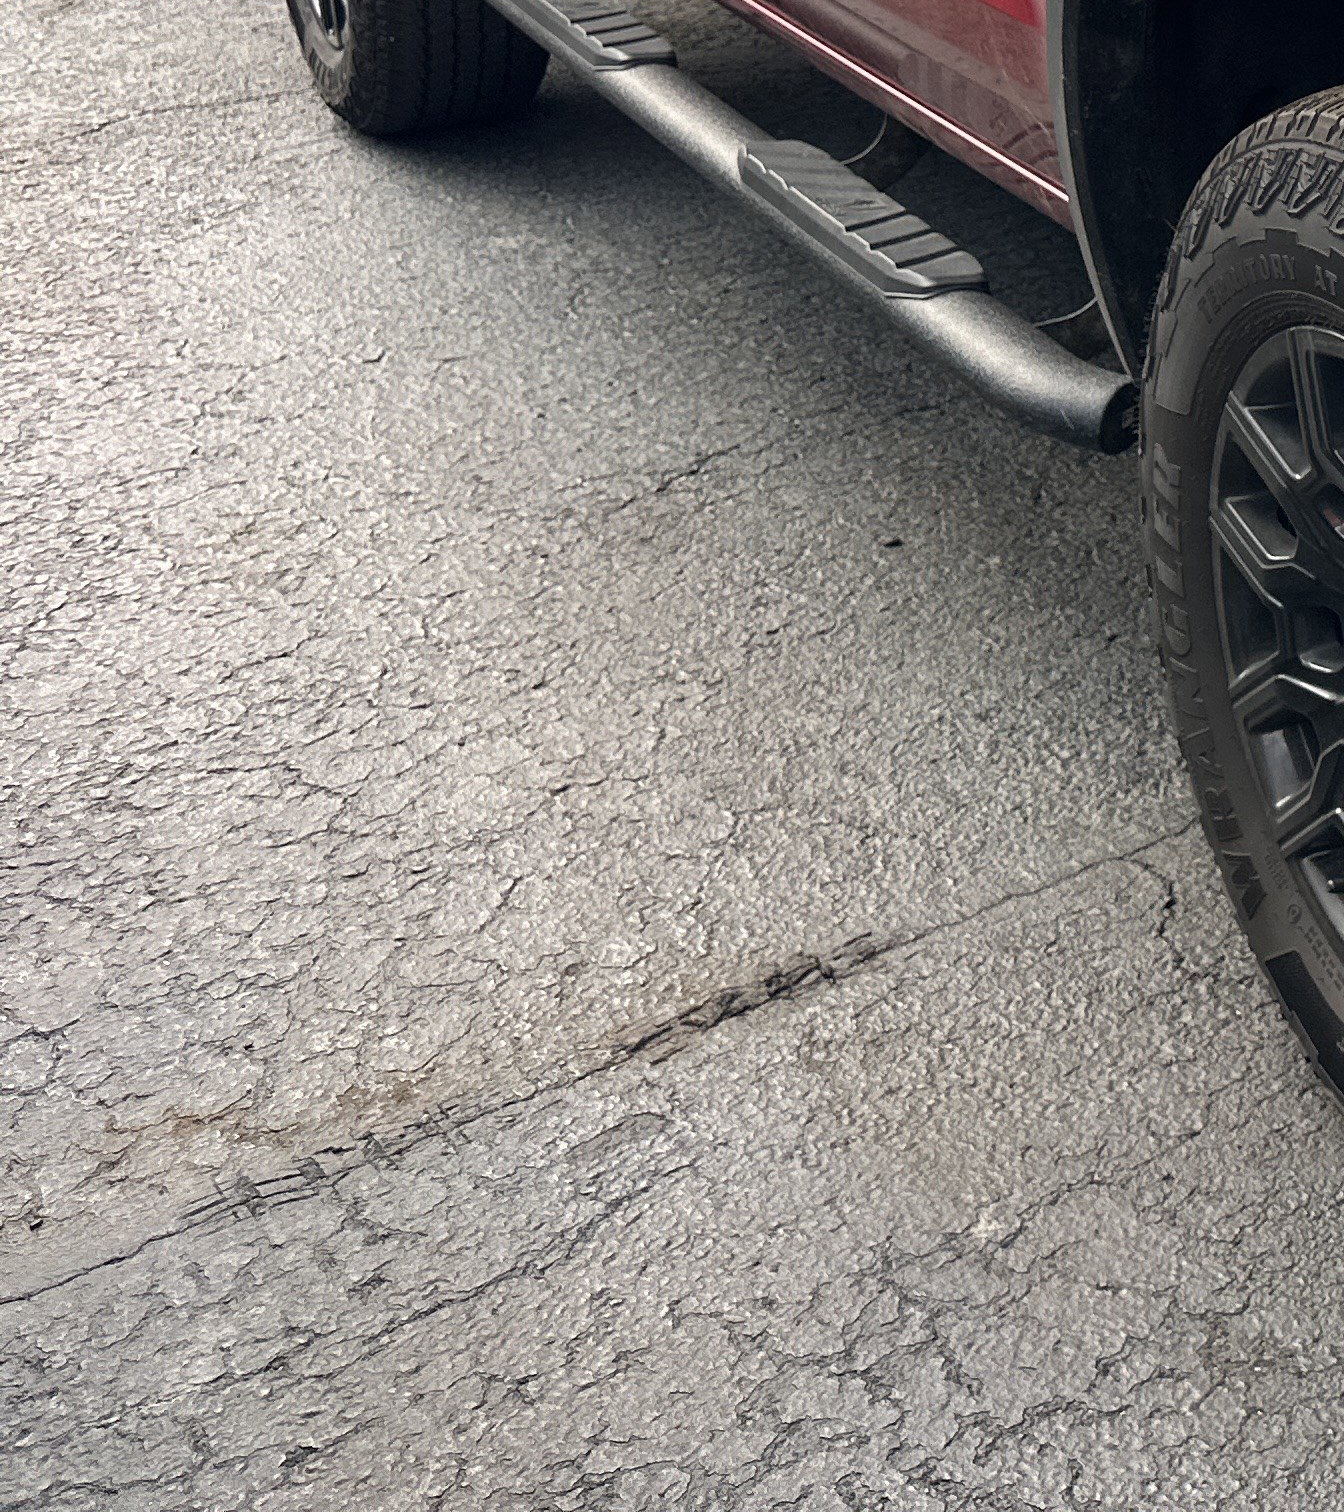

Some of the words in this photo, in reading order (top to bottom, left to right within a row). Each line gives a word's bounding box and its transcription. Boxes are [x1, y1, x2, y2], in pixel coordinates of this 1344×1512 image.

[1197, 253, 1297, 324] TERRITORY
[1313, 264, 1338, 296] AT
[1153, 441, 1267, 921] WRANGLER
